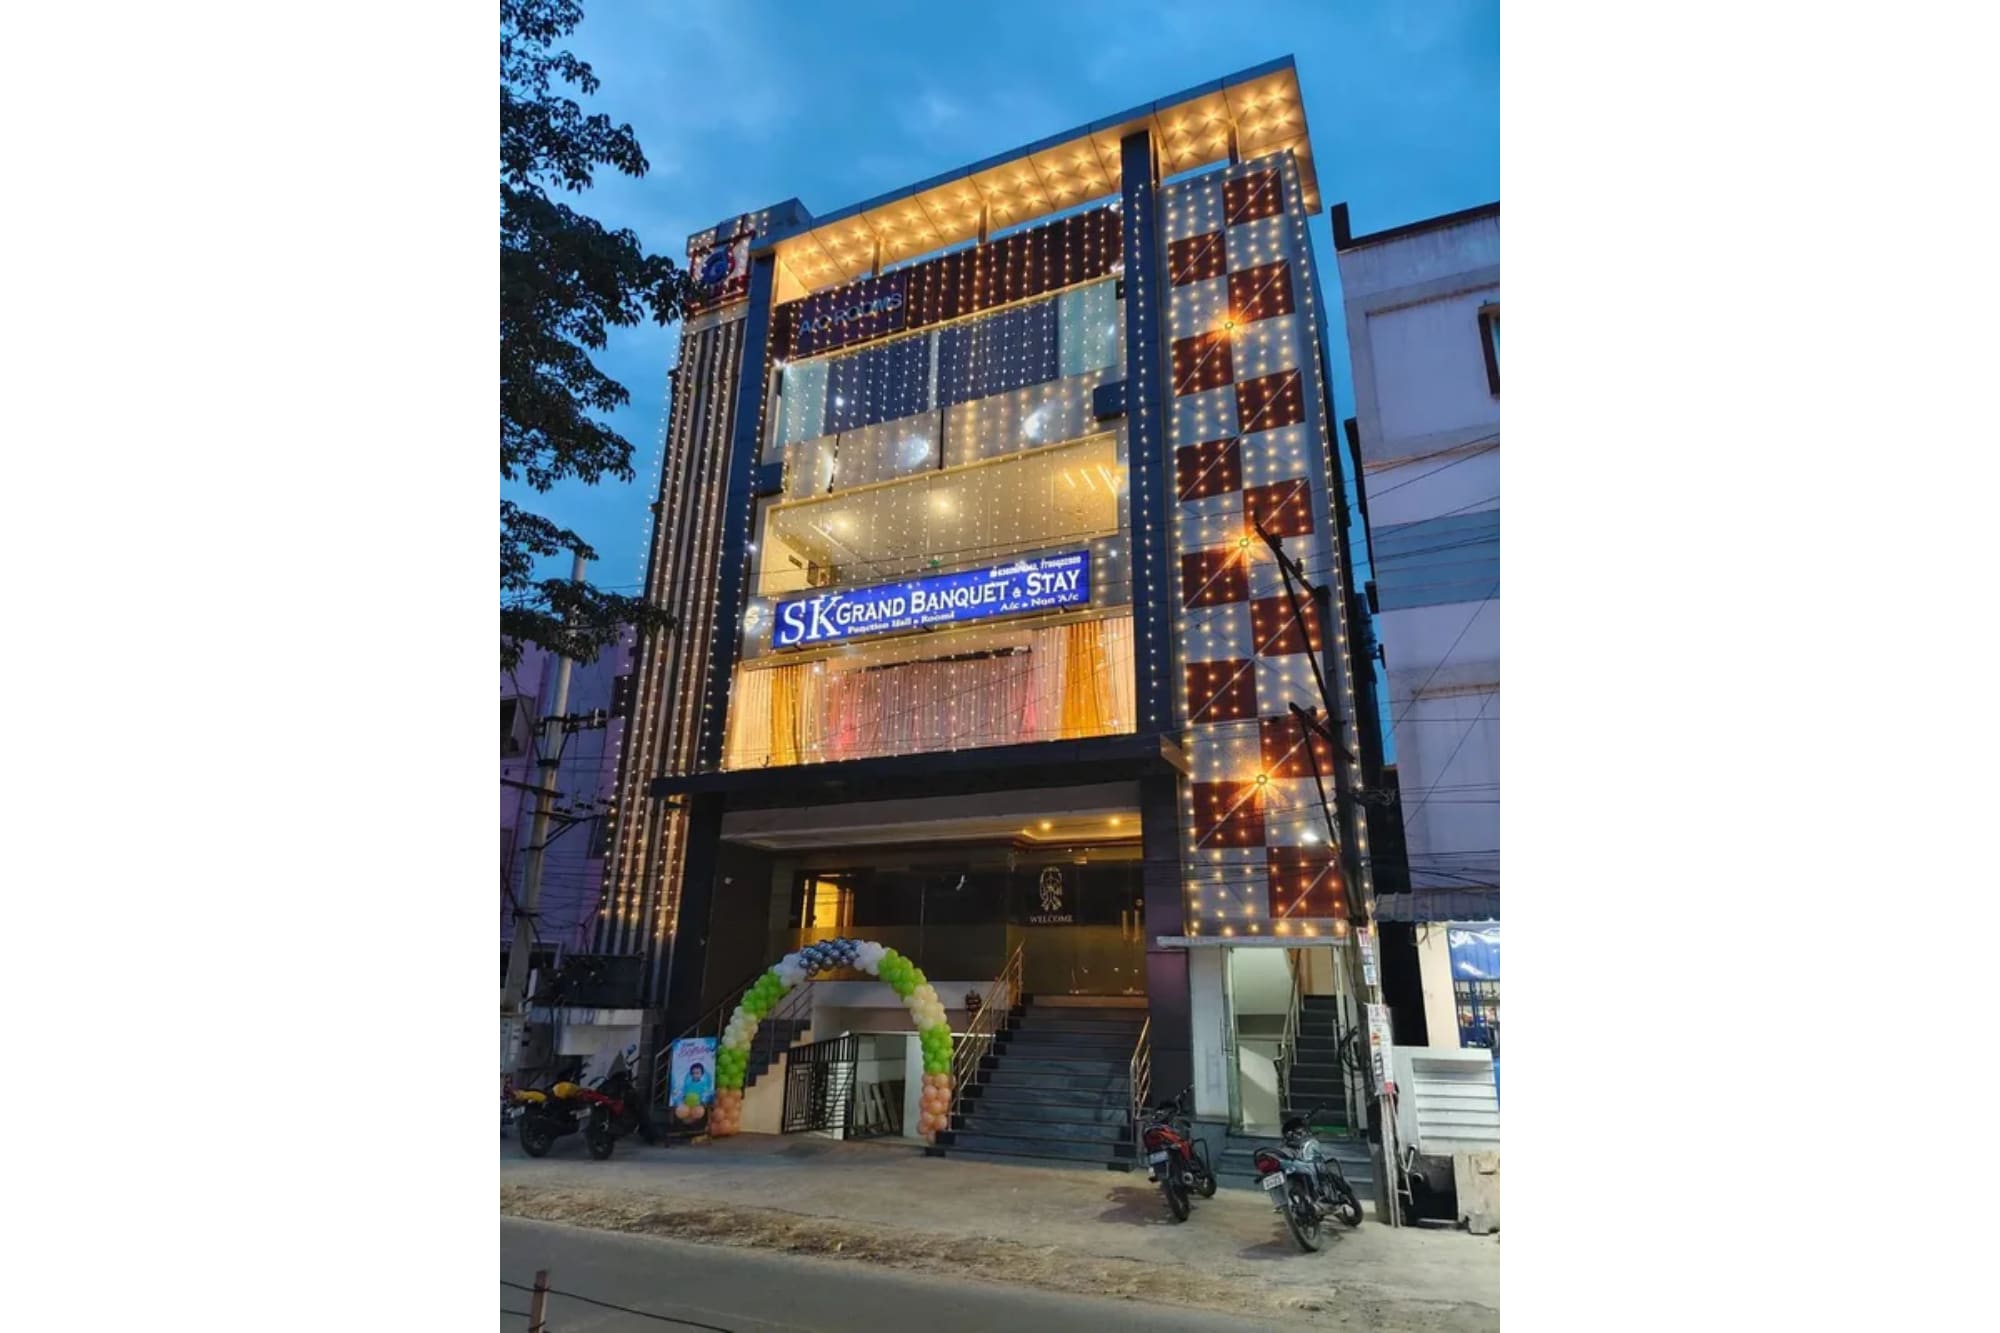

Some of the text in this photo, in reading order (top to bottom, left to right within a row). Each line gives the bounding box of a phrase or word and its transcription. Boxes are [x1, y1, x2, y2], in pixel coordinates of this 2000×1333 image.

[834, 292, 902, 326] ROOMS
[781, 595, 843, 644] SK
[836, 597, 906, 625] GRAND
[910, 581, 1009, 614] BANQUET
[1026, 569, 1081, 597] STAY
[1029, 914, 1073, 923] WELCOME
